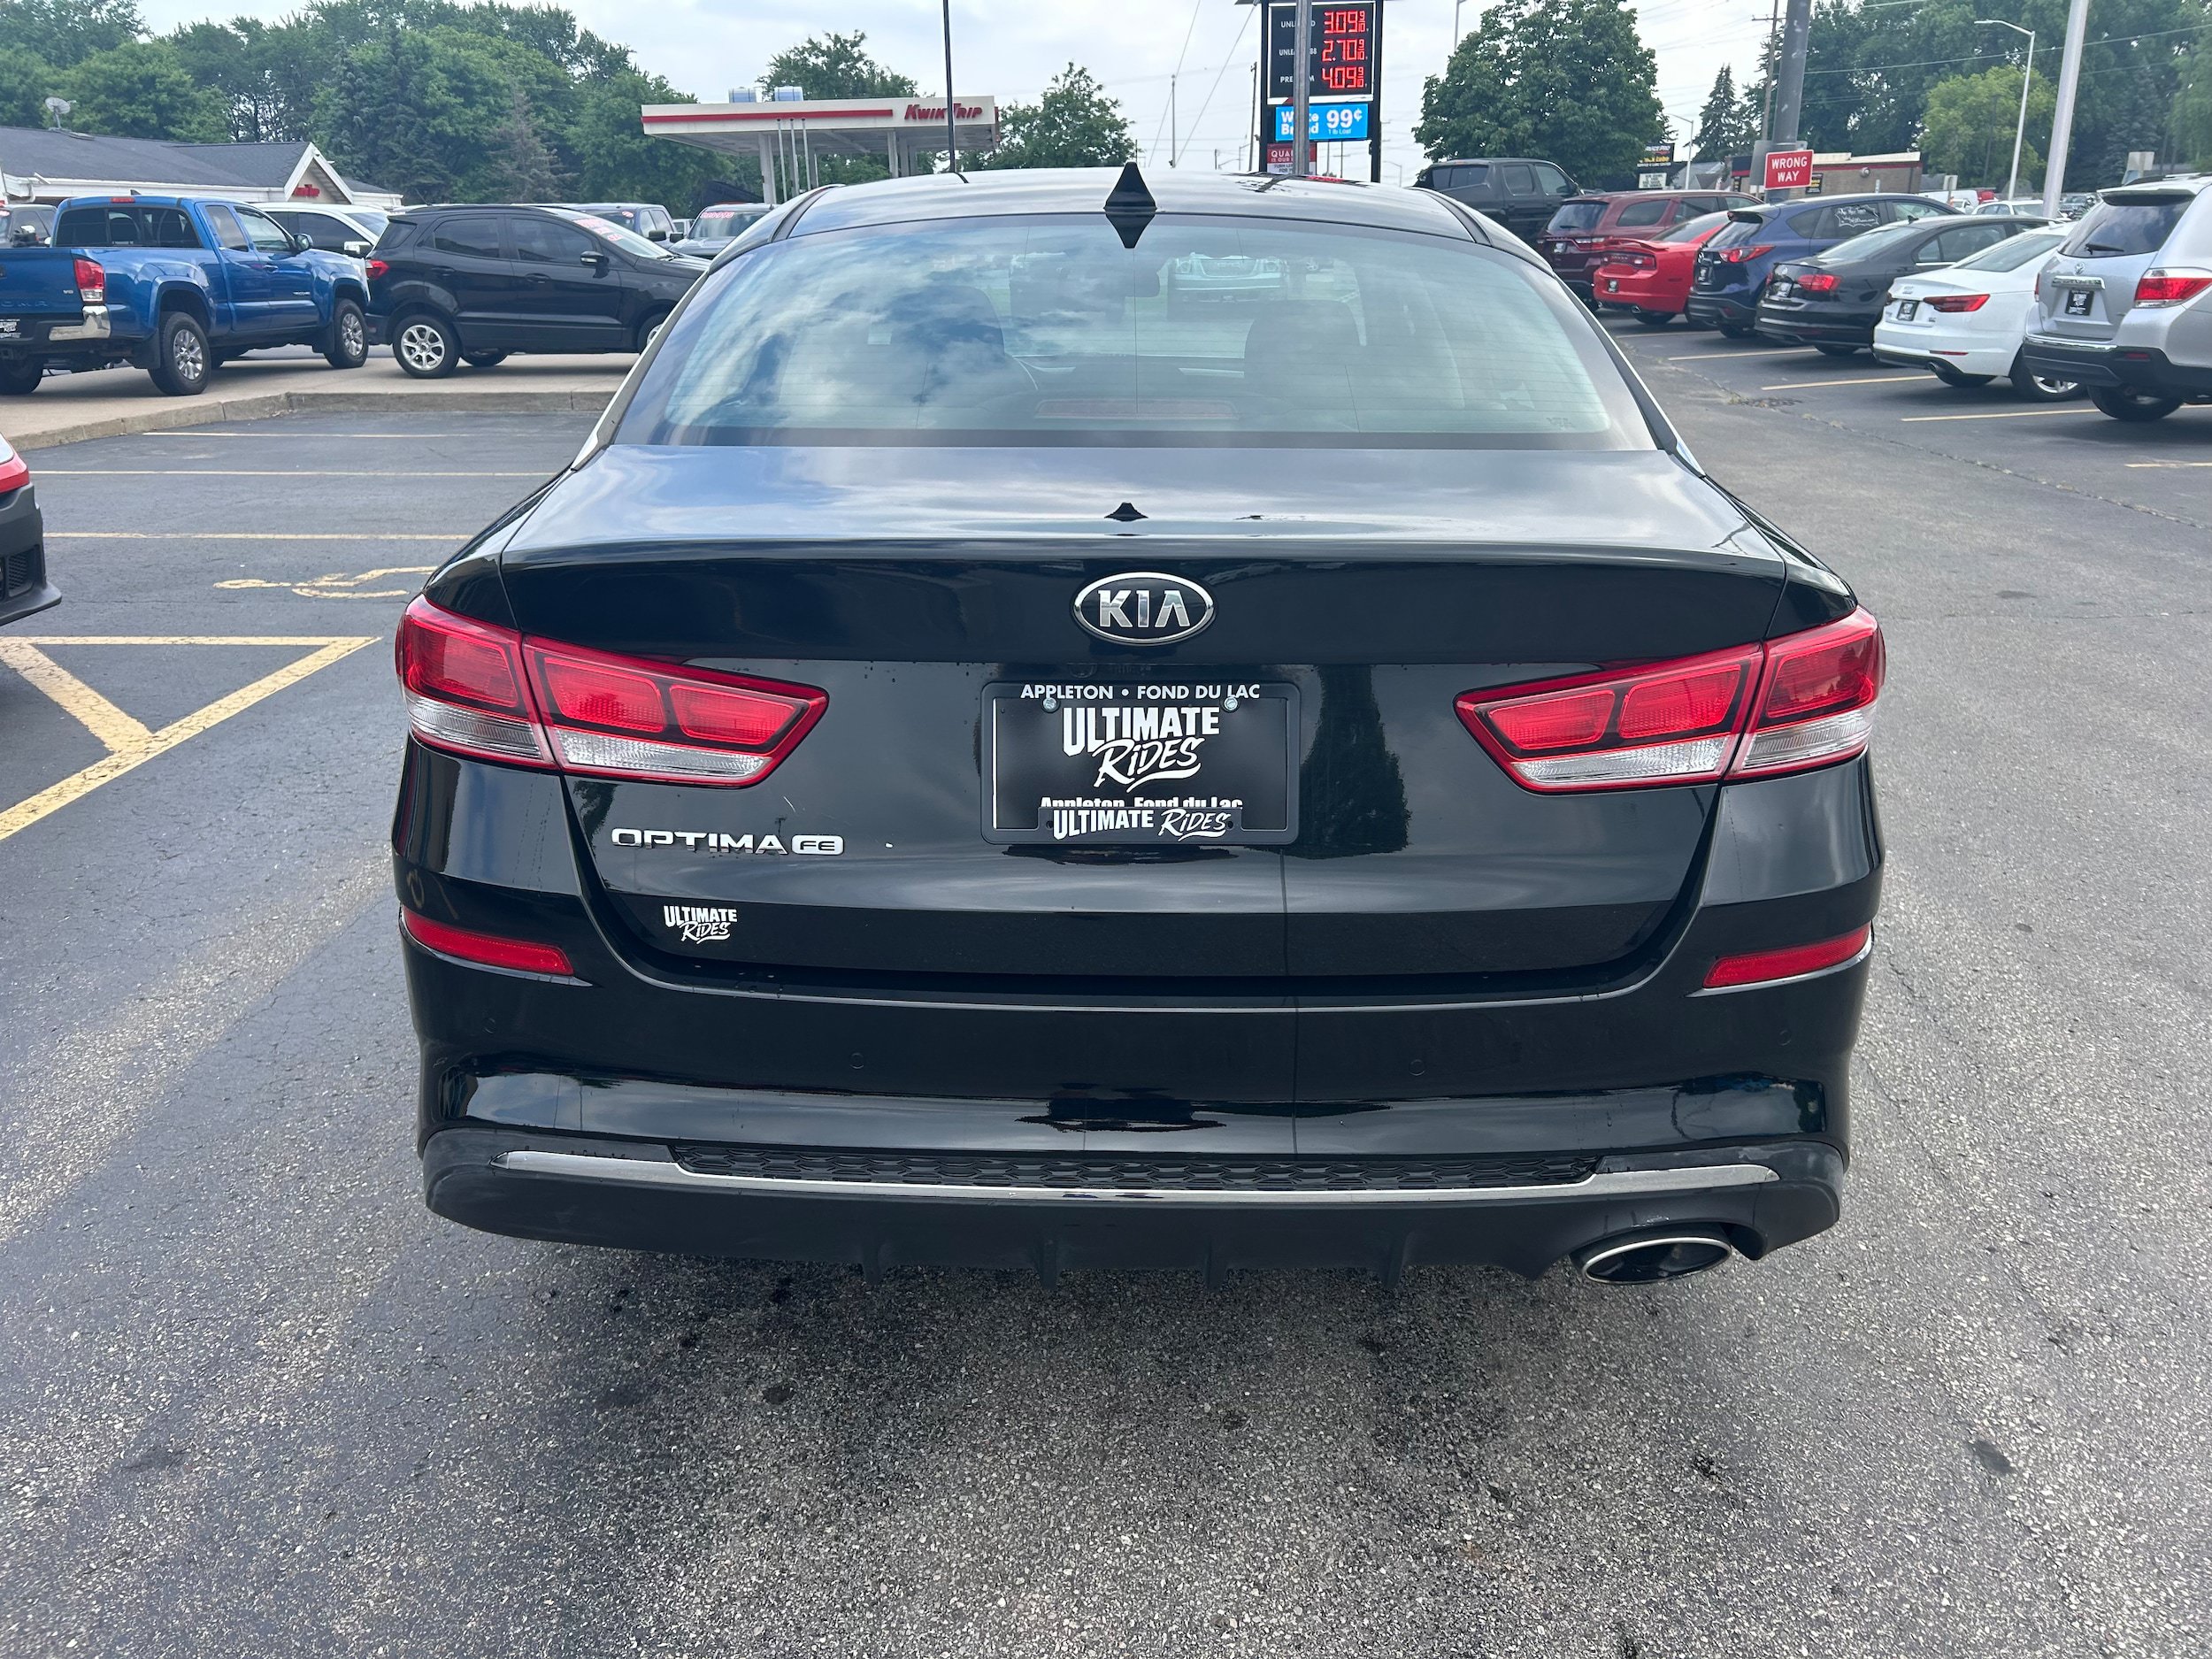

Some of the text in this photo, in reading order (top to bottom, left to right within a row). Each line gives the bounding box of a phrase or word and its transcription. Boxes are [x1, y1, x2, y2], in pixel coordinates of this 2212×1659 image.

[1771, 156, 1808, 170] WRONG
[1777, 170, 1800, 182] WAY
[1097, 589, 1191, 628] KIA
[1020, 684, 1261, 700] APPLETON FOND DU LAC
[1063, 707, 1220, 757] ULTIMATE
[1053, 809, 1155, 841] ULTIMATE
[611, 827, 788, 855] OPTIMA
[664, 905, 738, 928] ULTIMATE
